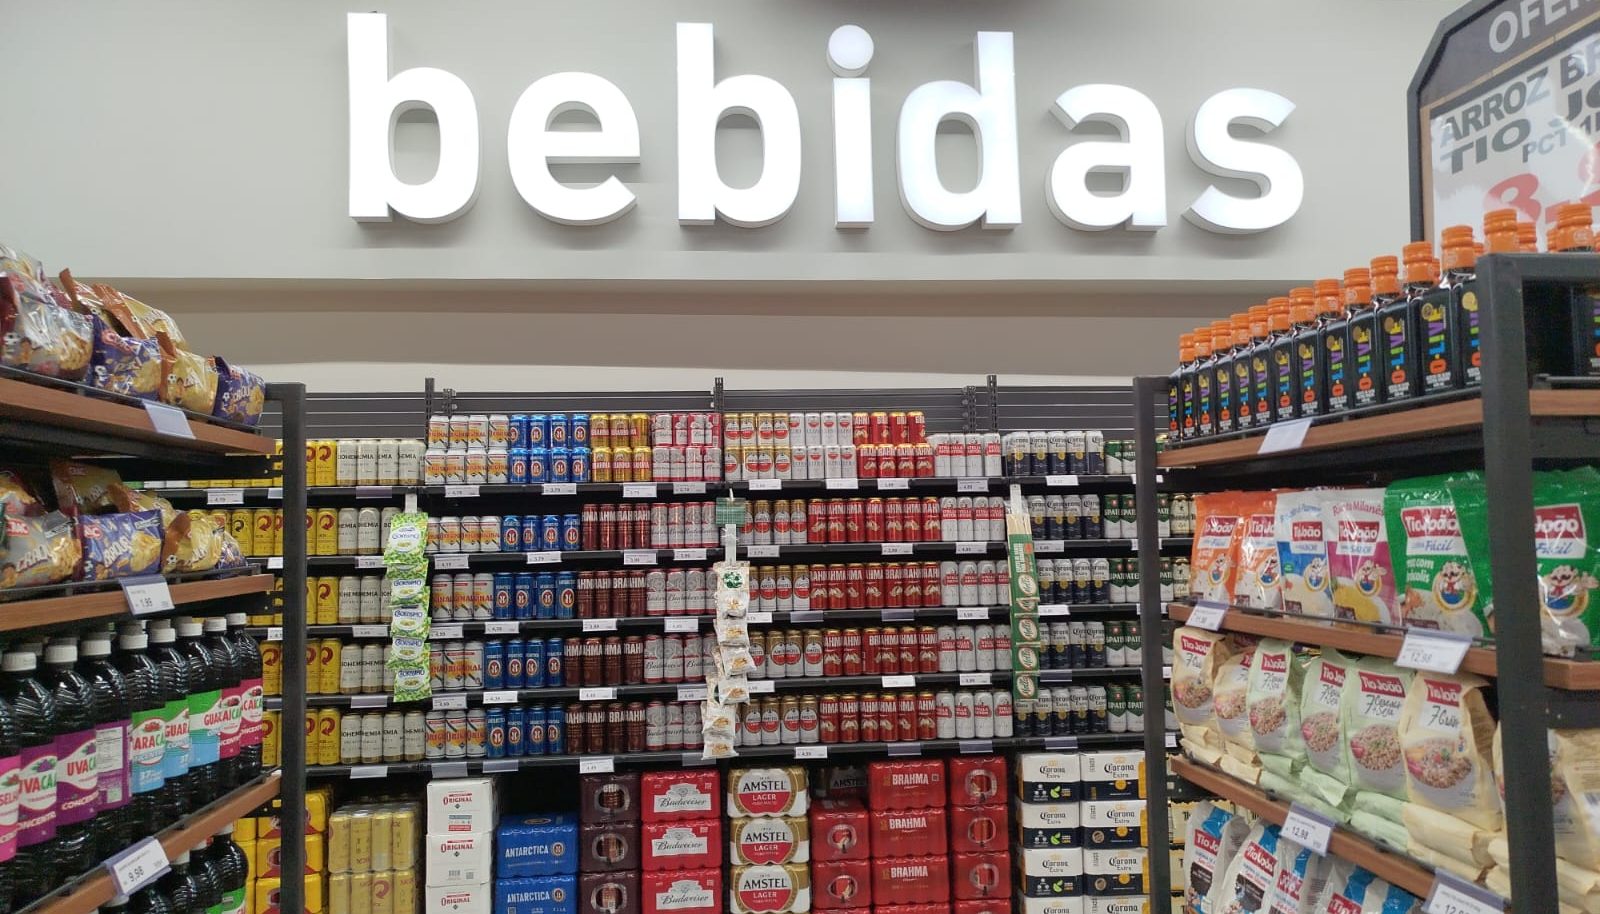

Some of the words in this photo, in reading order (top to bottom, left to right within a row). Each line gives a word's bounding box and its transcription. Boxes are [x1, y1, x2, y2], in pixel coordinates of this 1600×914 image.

[1439, 66, 1549, 148] ARROZ
[348, 11, 1306, 228] bebidas
[1440, 118, 1531, 174] TIO
[1040, 765, 1066, 774] Corona
[1104, 763, 1135, 773] Corona
[892, 773, 929, 786] BRAHMA
[742, 781, 787, 793] AMSTEL
[443, 796, 472, 805] ORIGINAL
[752, 793, 777, 801] LAGER
[659, 796, 707, 809] Budweiser
[1040, 811, 1066, 820] Corona
[1107, 810, 1135, 820] Corona
[889, 816, 927, 829] BRAHMA
[744, 831, 788, 842] AMSTEL
[440, 843, 474, 853] ORIGINAL
[505, 844, 549, 858] ANTARCTICA
[655, 841, 703, 852] Budweiser
[754, 843, 778, 852] LAGER
[1042, 859, 1069, 868] Corona
[1109, 857, 1137, 867] Corona
[890, 866, 928, 878] BRAHMA
[743, 879, 787, 889] AMSTEL
[507, 891, 550, 903] ANTARCTICA
[661, 894, 709, 905] Budweiser
[753, 891, 777, 899] LAGER
[440, 897, 470, 907] ORIGINAL
